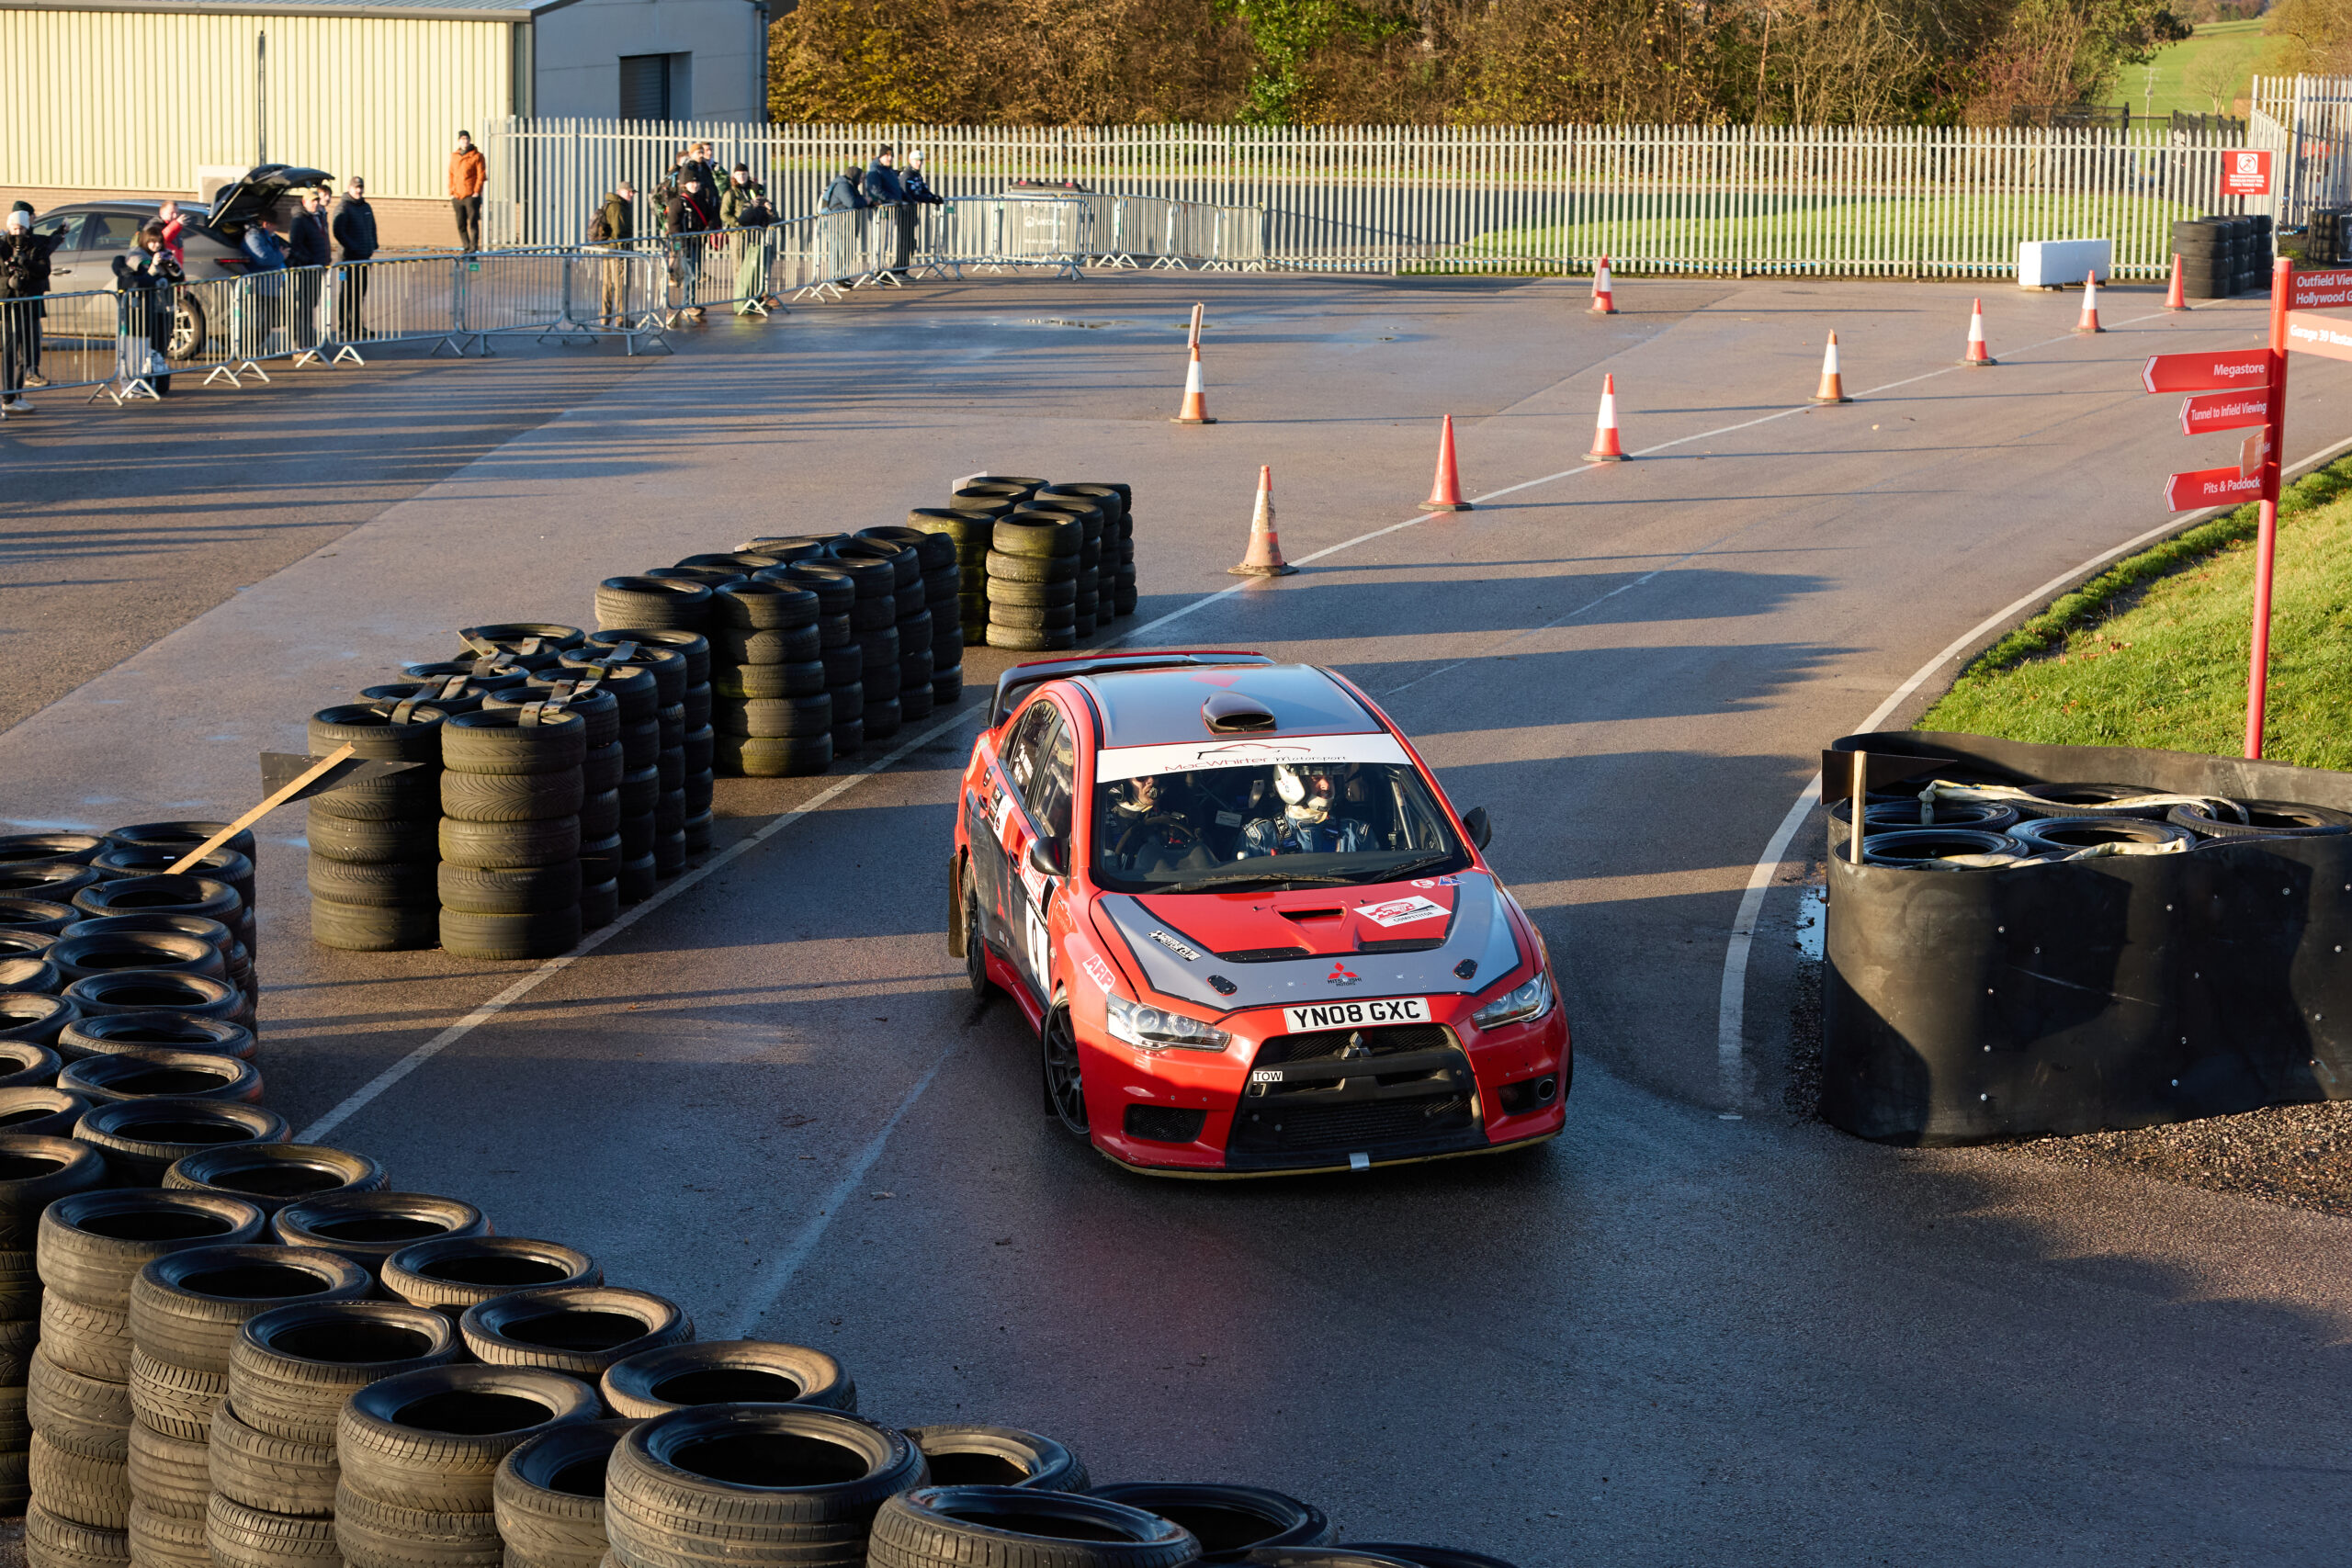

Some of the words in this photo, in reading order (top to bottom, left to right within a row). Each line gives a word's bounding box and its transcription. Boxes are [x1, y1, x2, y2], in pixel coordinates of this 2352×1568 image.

[2297, 274, 2335, 288] Outfield
[2296, 291, 2345, 307] Hollywood
[2290, 324, 2318, 343] Garage
[2213, 364, 2265, 378] Megastore
[2191, 407, 2212, 421] Tunnel
[2212, 407, 2220, 418] to
[2221, 402, 2241, 417] Infield
[2242, 401, 2267, 415] Viewing
[2203, 480, 2218, 494] Pits
[2219, 480, 2226, 492] &
[2227, 476, 2260, 491] Paddock
[1164, 757, 1268, 771] MacWhirter
[1393, 911, 1434, 922] COMPETITOR
[1087, 956, 1114, 987] ARP
[1293, 1004, 1363, 1028] YN08
[1369, 1000, 1420, 1021] GXC
[1254, 1071, 1283, 1081] TOW
